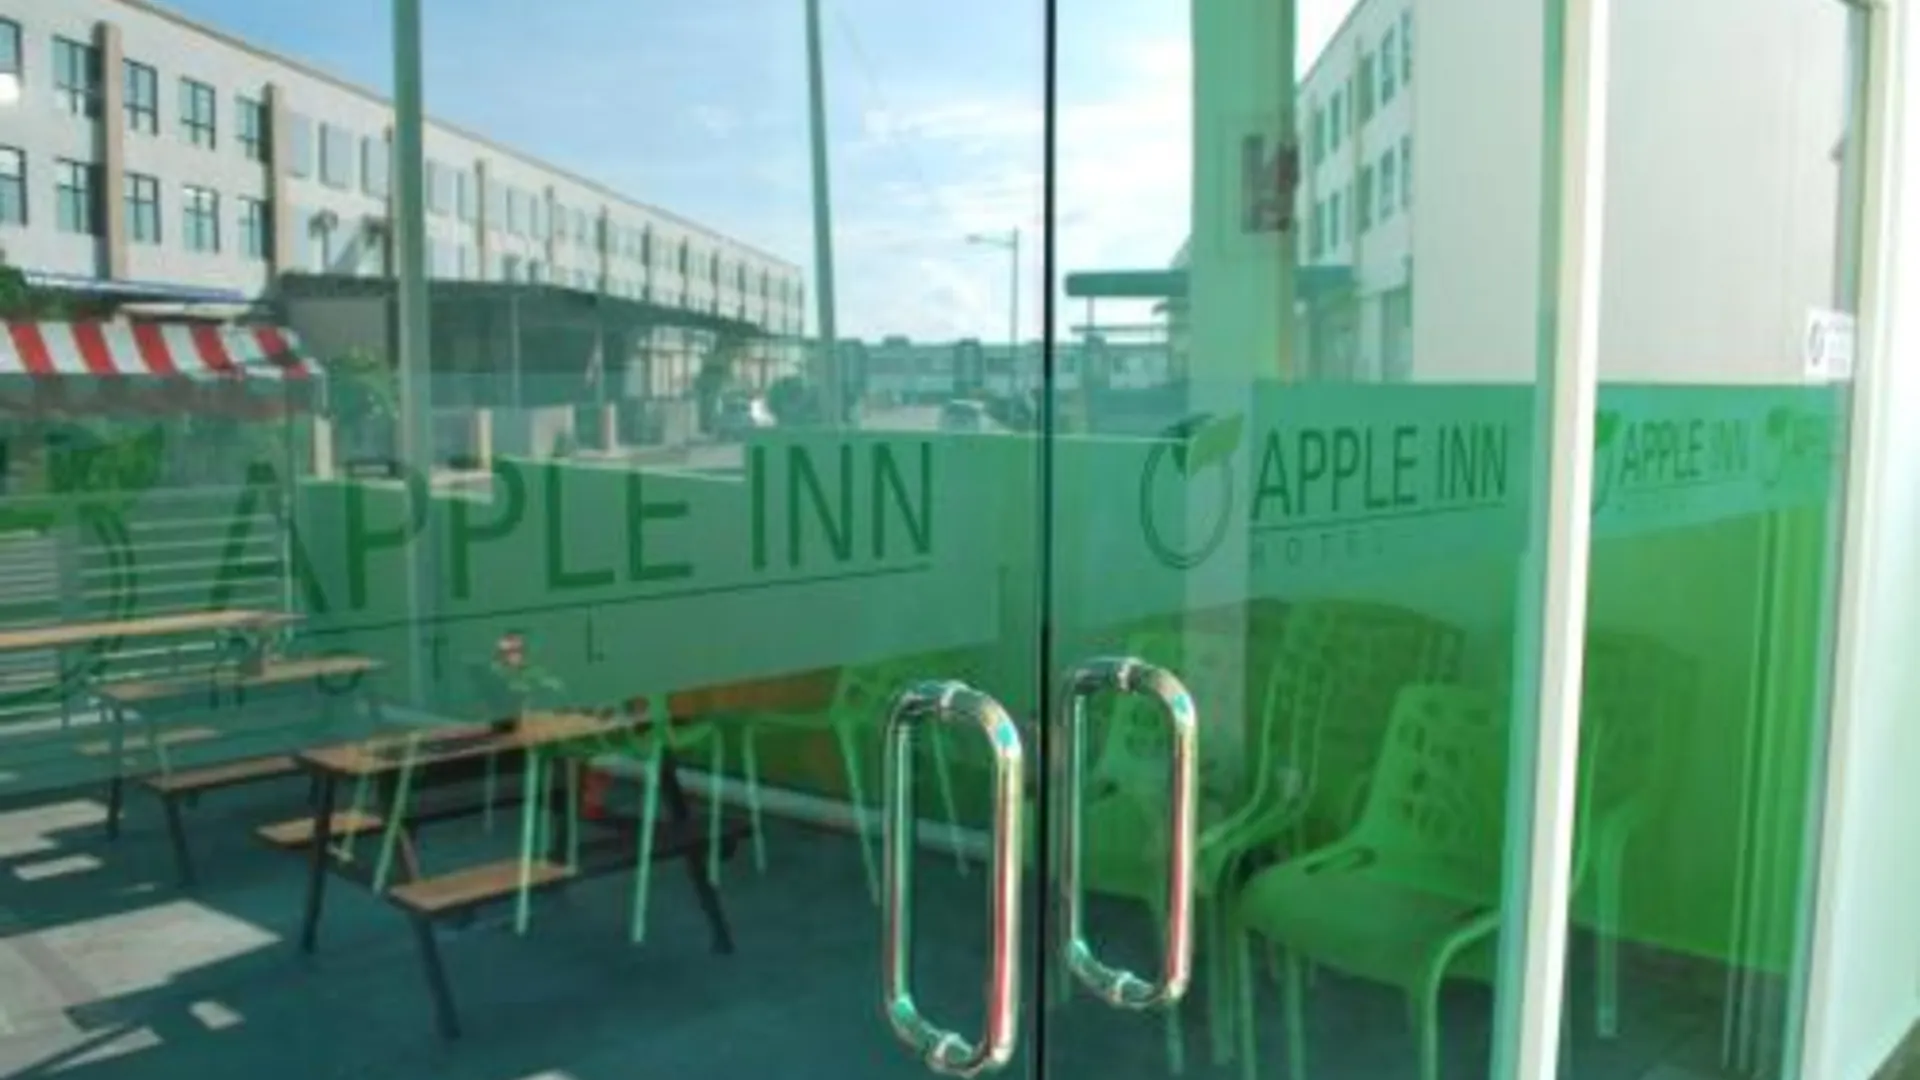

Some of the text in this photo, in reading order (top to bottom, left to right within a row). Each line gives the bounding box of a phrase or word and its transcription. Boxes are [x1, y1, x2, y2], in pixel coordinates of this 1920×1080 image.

[1251, 421, 1508, 520] APPLE INN
[1618, 416, 1705, 486] APPLE
[208, 440, 933, 616] APPLE INN
